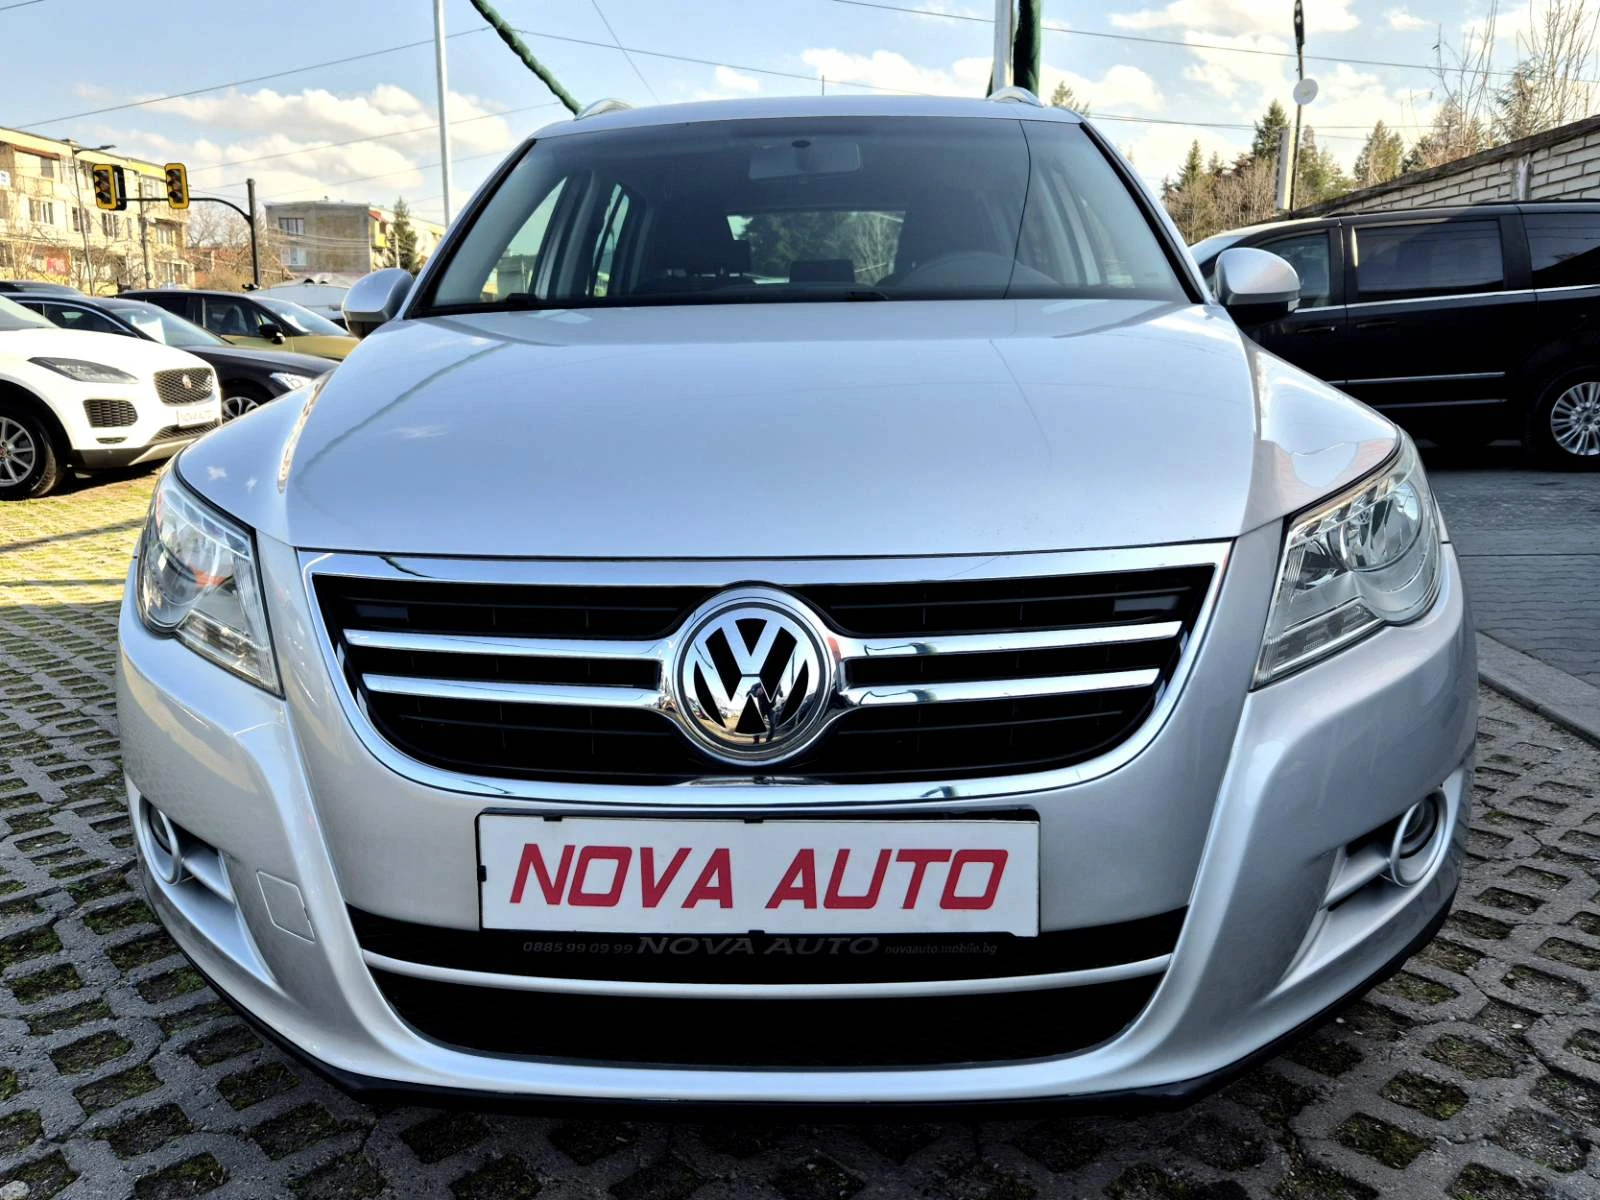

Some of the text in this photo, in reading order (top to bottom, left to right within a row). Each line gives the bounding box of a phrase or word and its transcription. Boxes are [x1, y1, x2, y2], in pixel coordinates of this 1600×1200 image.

[509, 843, 1009, 910] NOVA AUTO
[522, 941, 564, 953] 0885
[566, 942, 587, 954] 99
[590, 942, 610, 954] 09
[613, 943, 634, 955] 99
[637, 936, 755, 955] NOVA
[763, 936, 880, 955] AUTO
